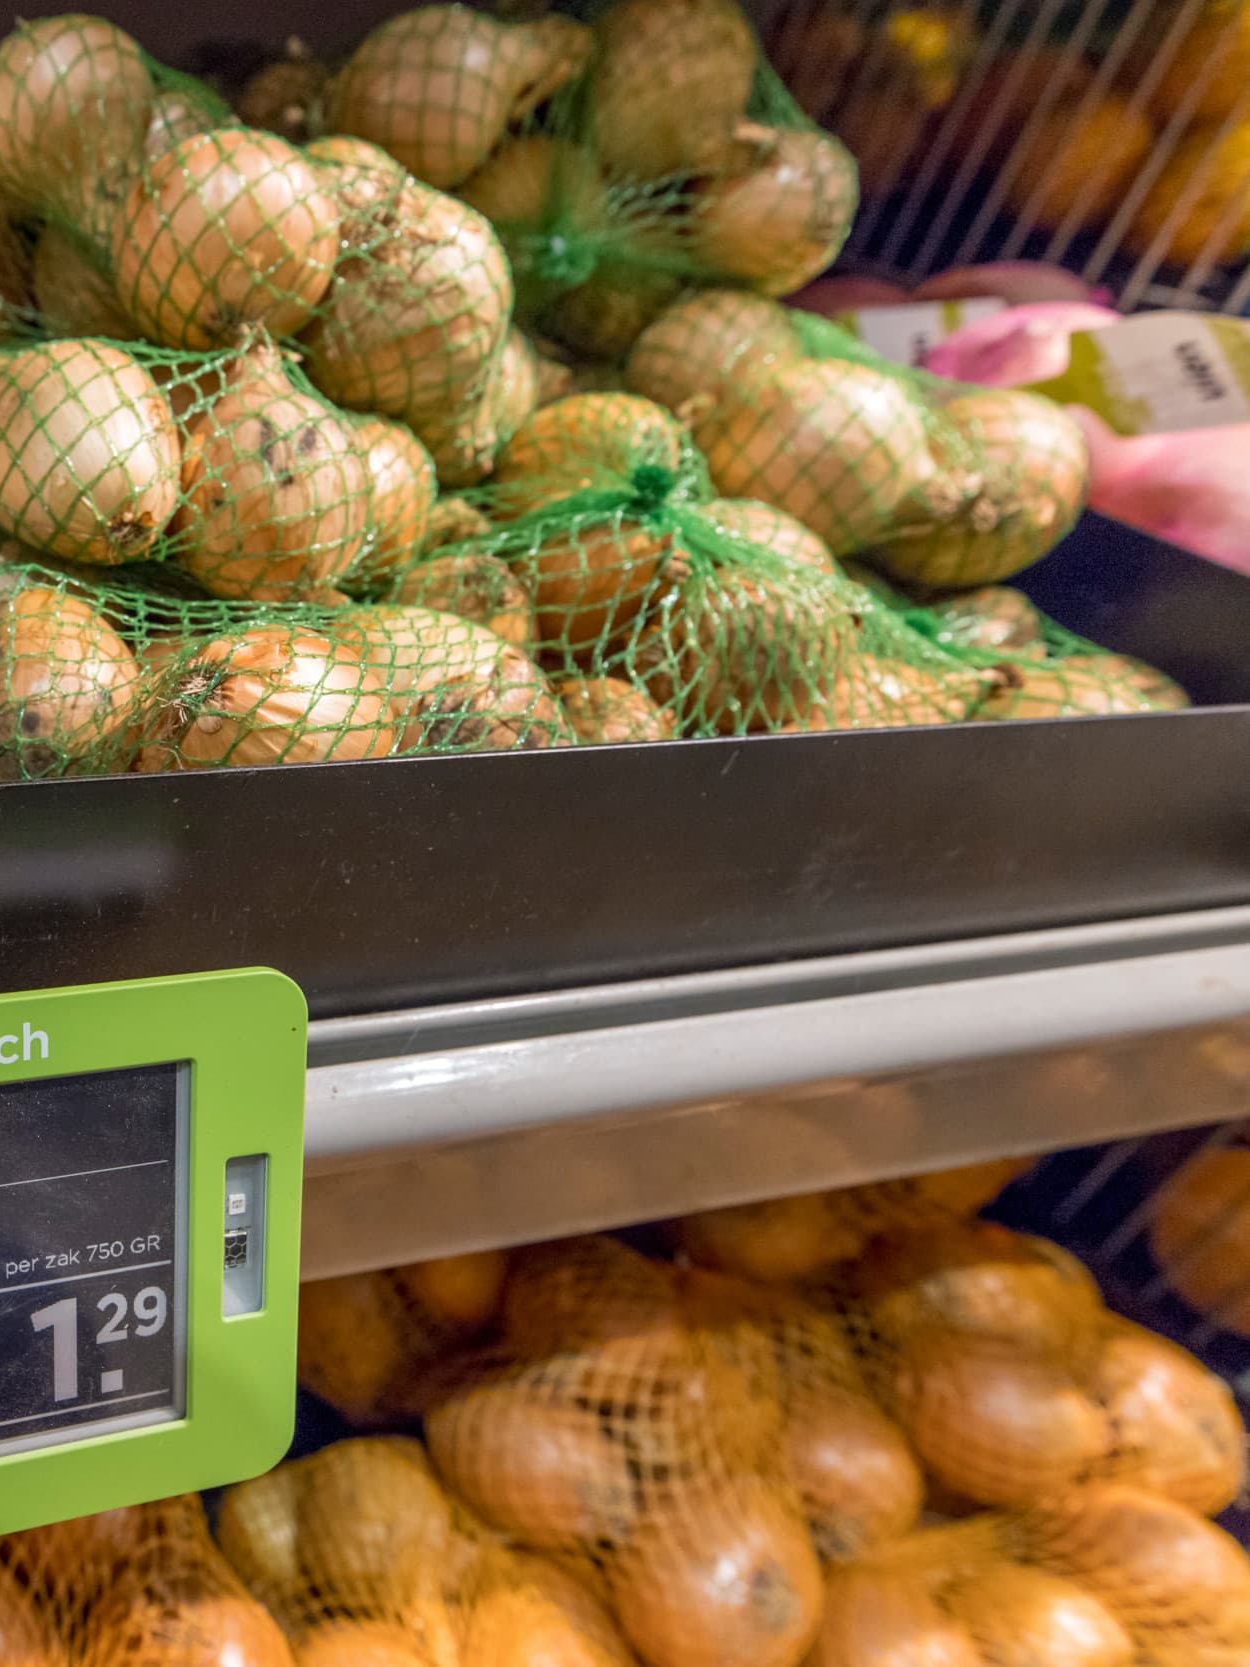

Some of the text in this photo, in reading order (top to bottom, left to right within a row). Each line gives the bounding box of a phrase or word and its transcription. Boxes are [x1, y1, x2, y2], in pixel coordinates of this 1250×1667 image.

[5, 1256, 39, 1279] per
[45, 1248, 80, 1269] zak
[86, 1240, 124, 1263] 750
[130, 1234, 161, 1254] GR
